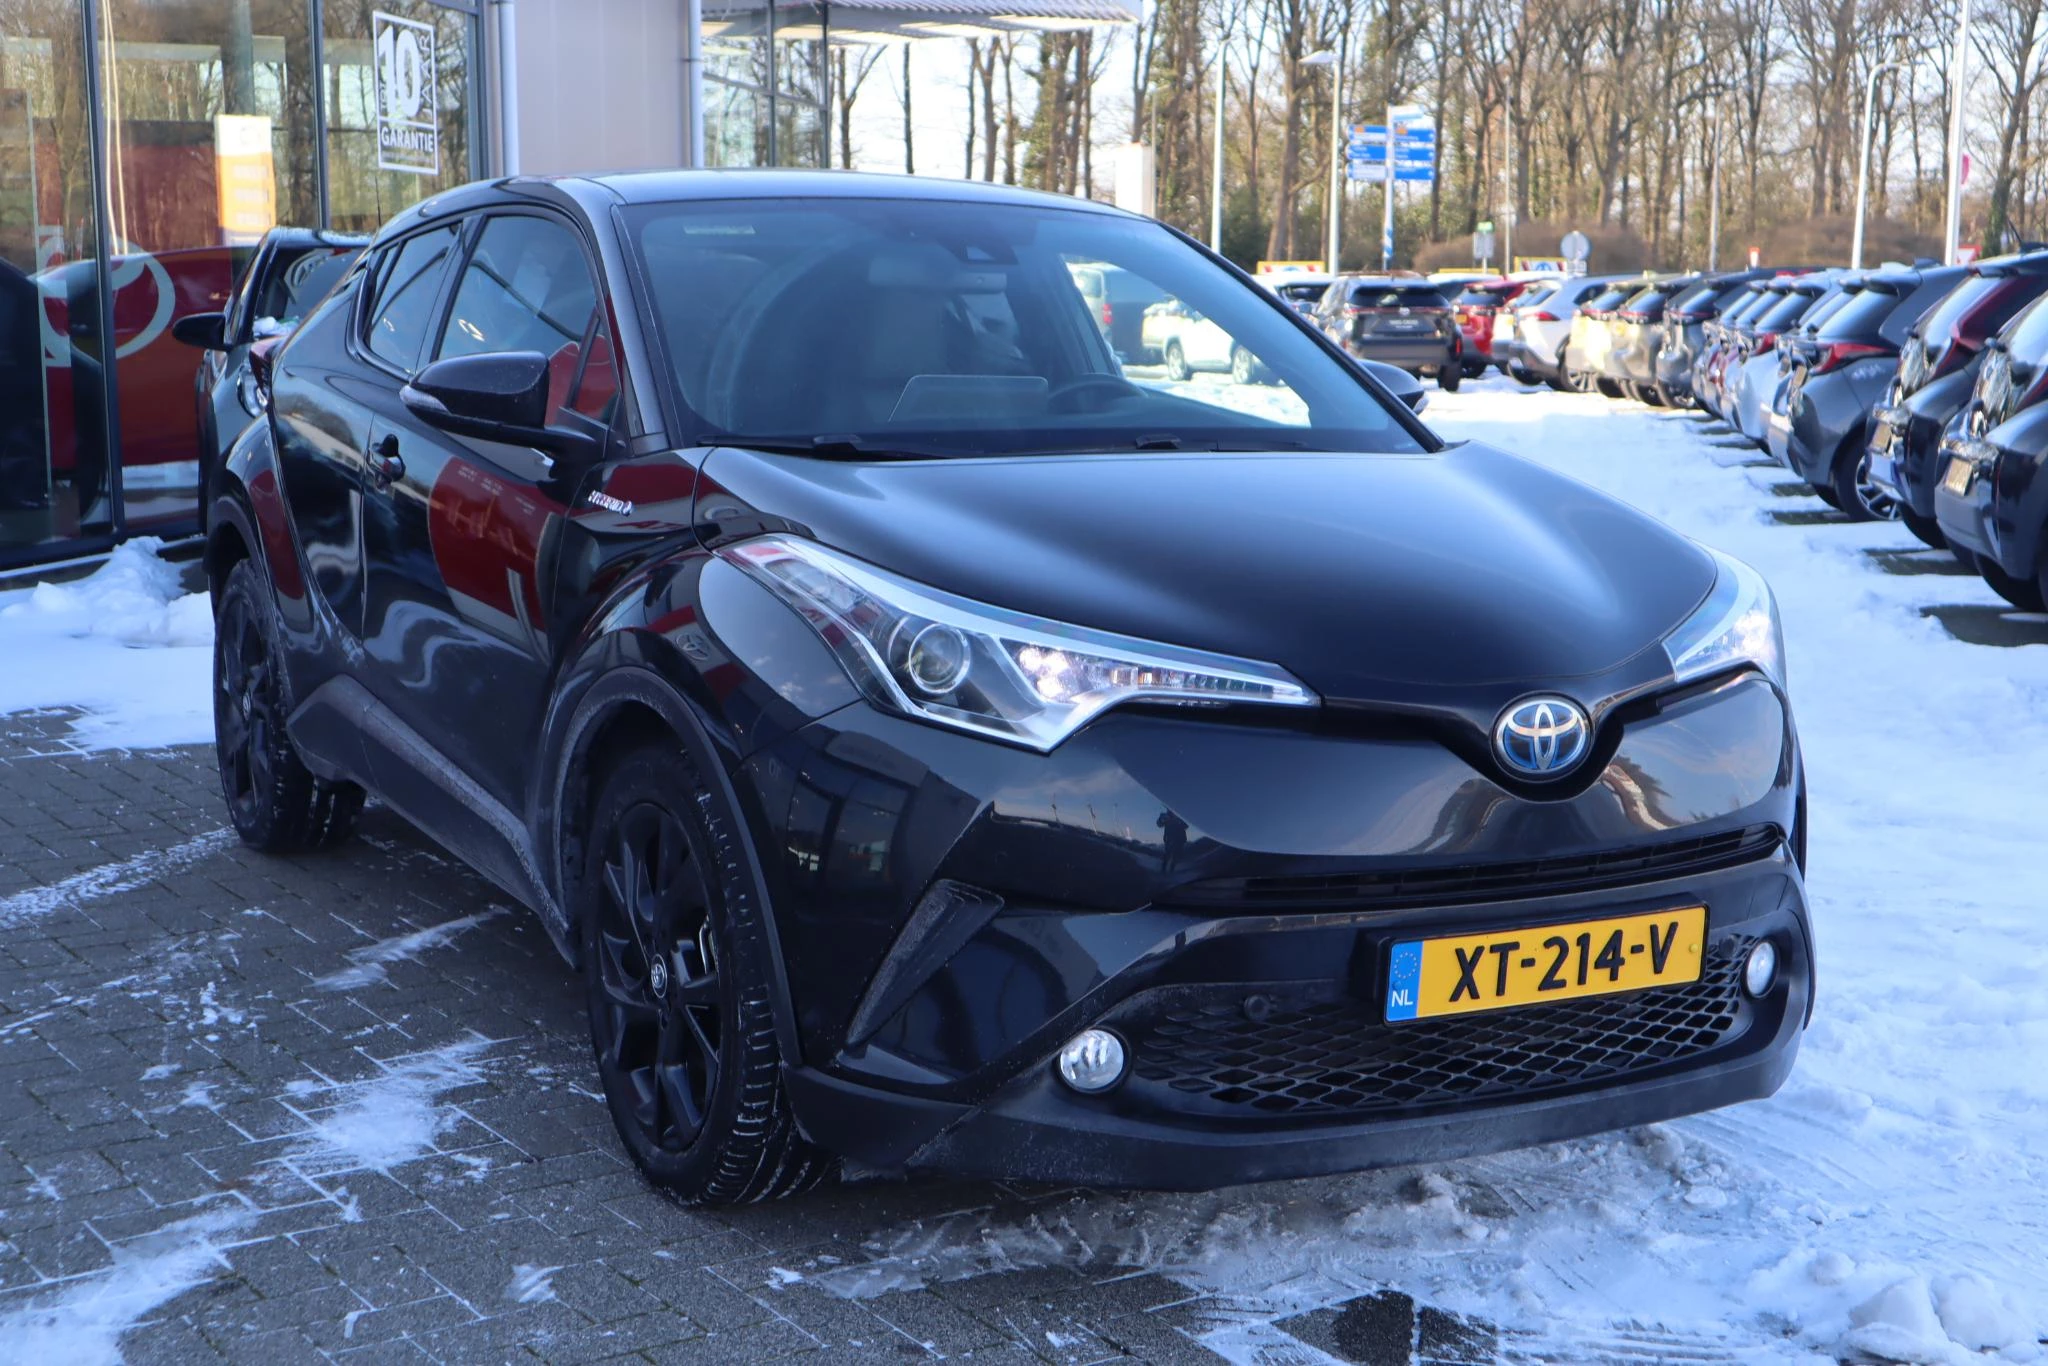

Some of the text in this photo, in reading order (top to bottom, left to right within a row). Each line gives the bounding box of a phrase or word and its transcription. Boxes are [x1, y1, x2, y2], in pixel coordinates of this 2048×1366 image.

[378, 25, 421, 118] 10
[419, 34, 433, 119] JAAR
[381, 127, 434, 152] GARANTIE
[1391, 990, 1414, 1007] NL
[1449, 921, 1679, 1003] XT-214-V
